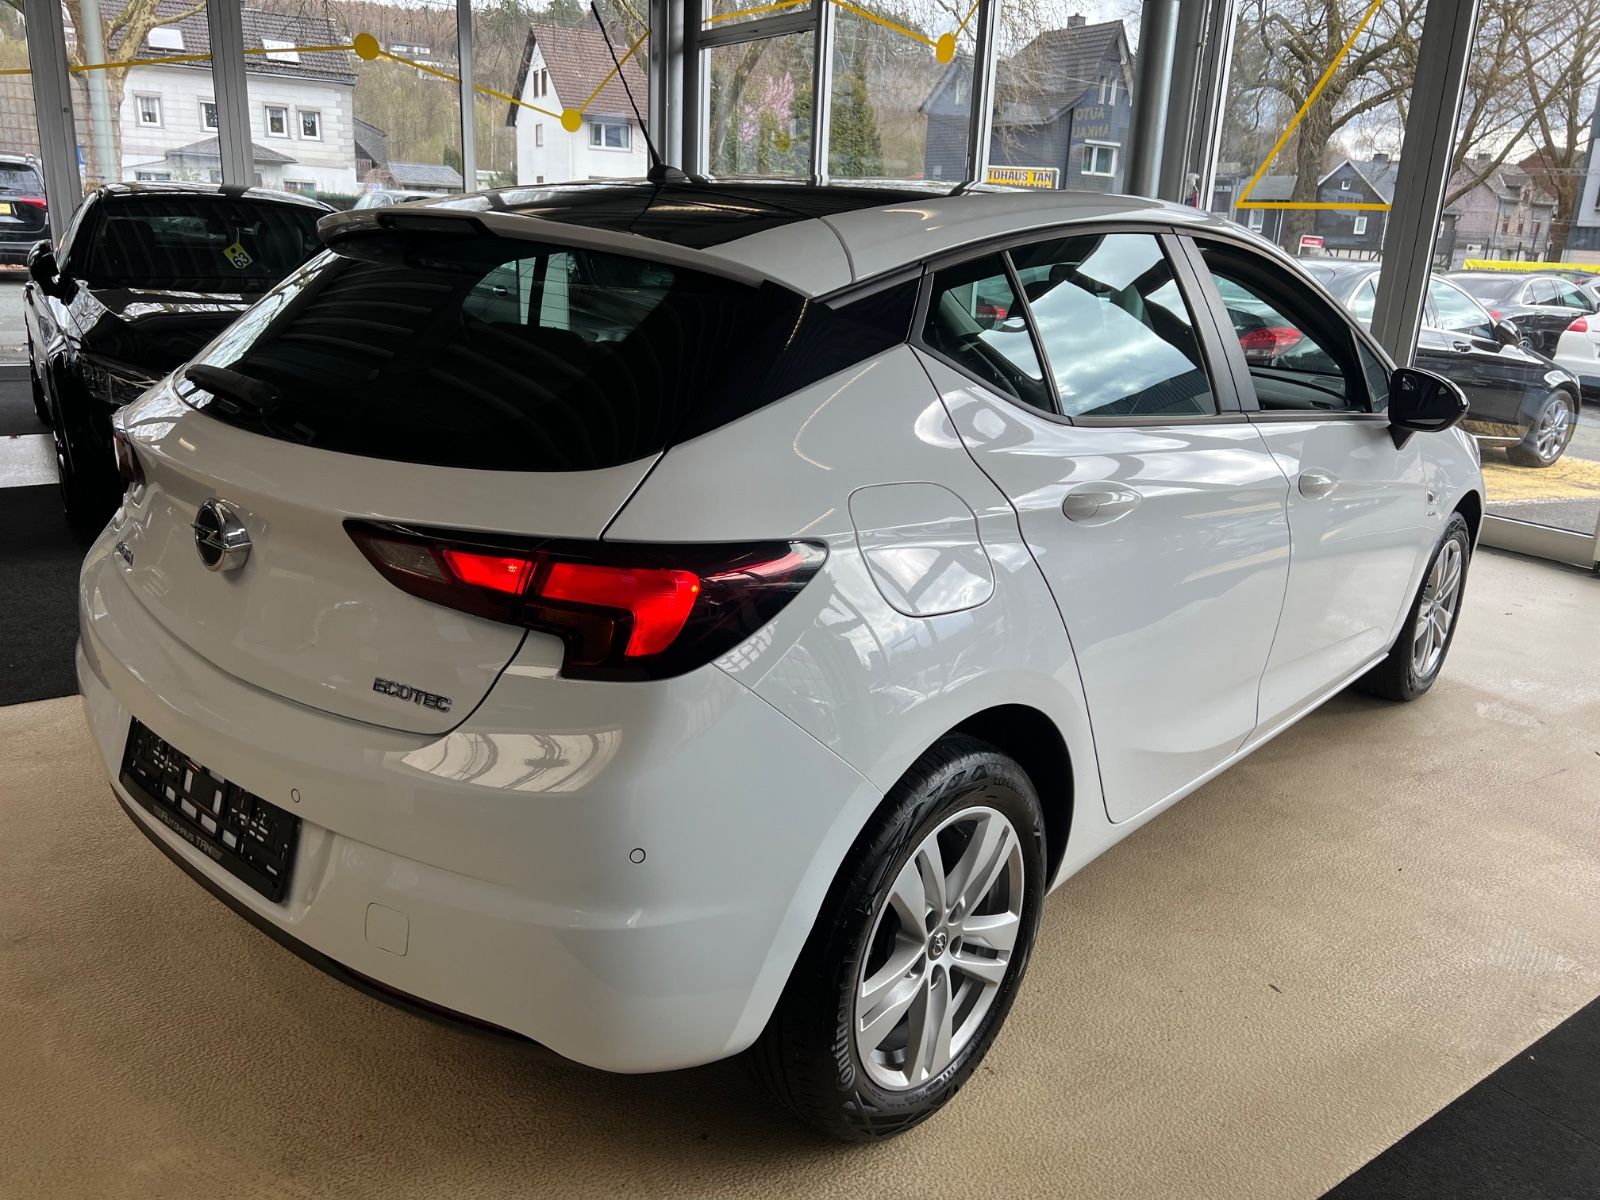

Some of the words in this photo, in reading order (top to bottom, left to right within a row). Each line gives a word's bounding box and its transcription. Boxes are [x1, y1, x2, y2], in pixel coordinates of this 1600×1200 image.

[1032, 172, 1052, 183] TAN
[233, 253, 249, 267] 63
[372, 677, 452, 713] ECOTEC
